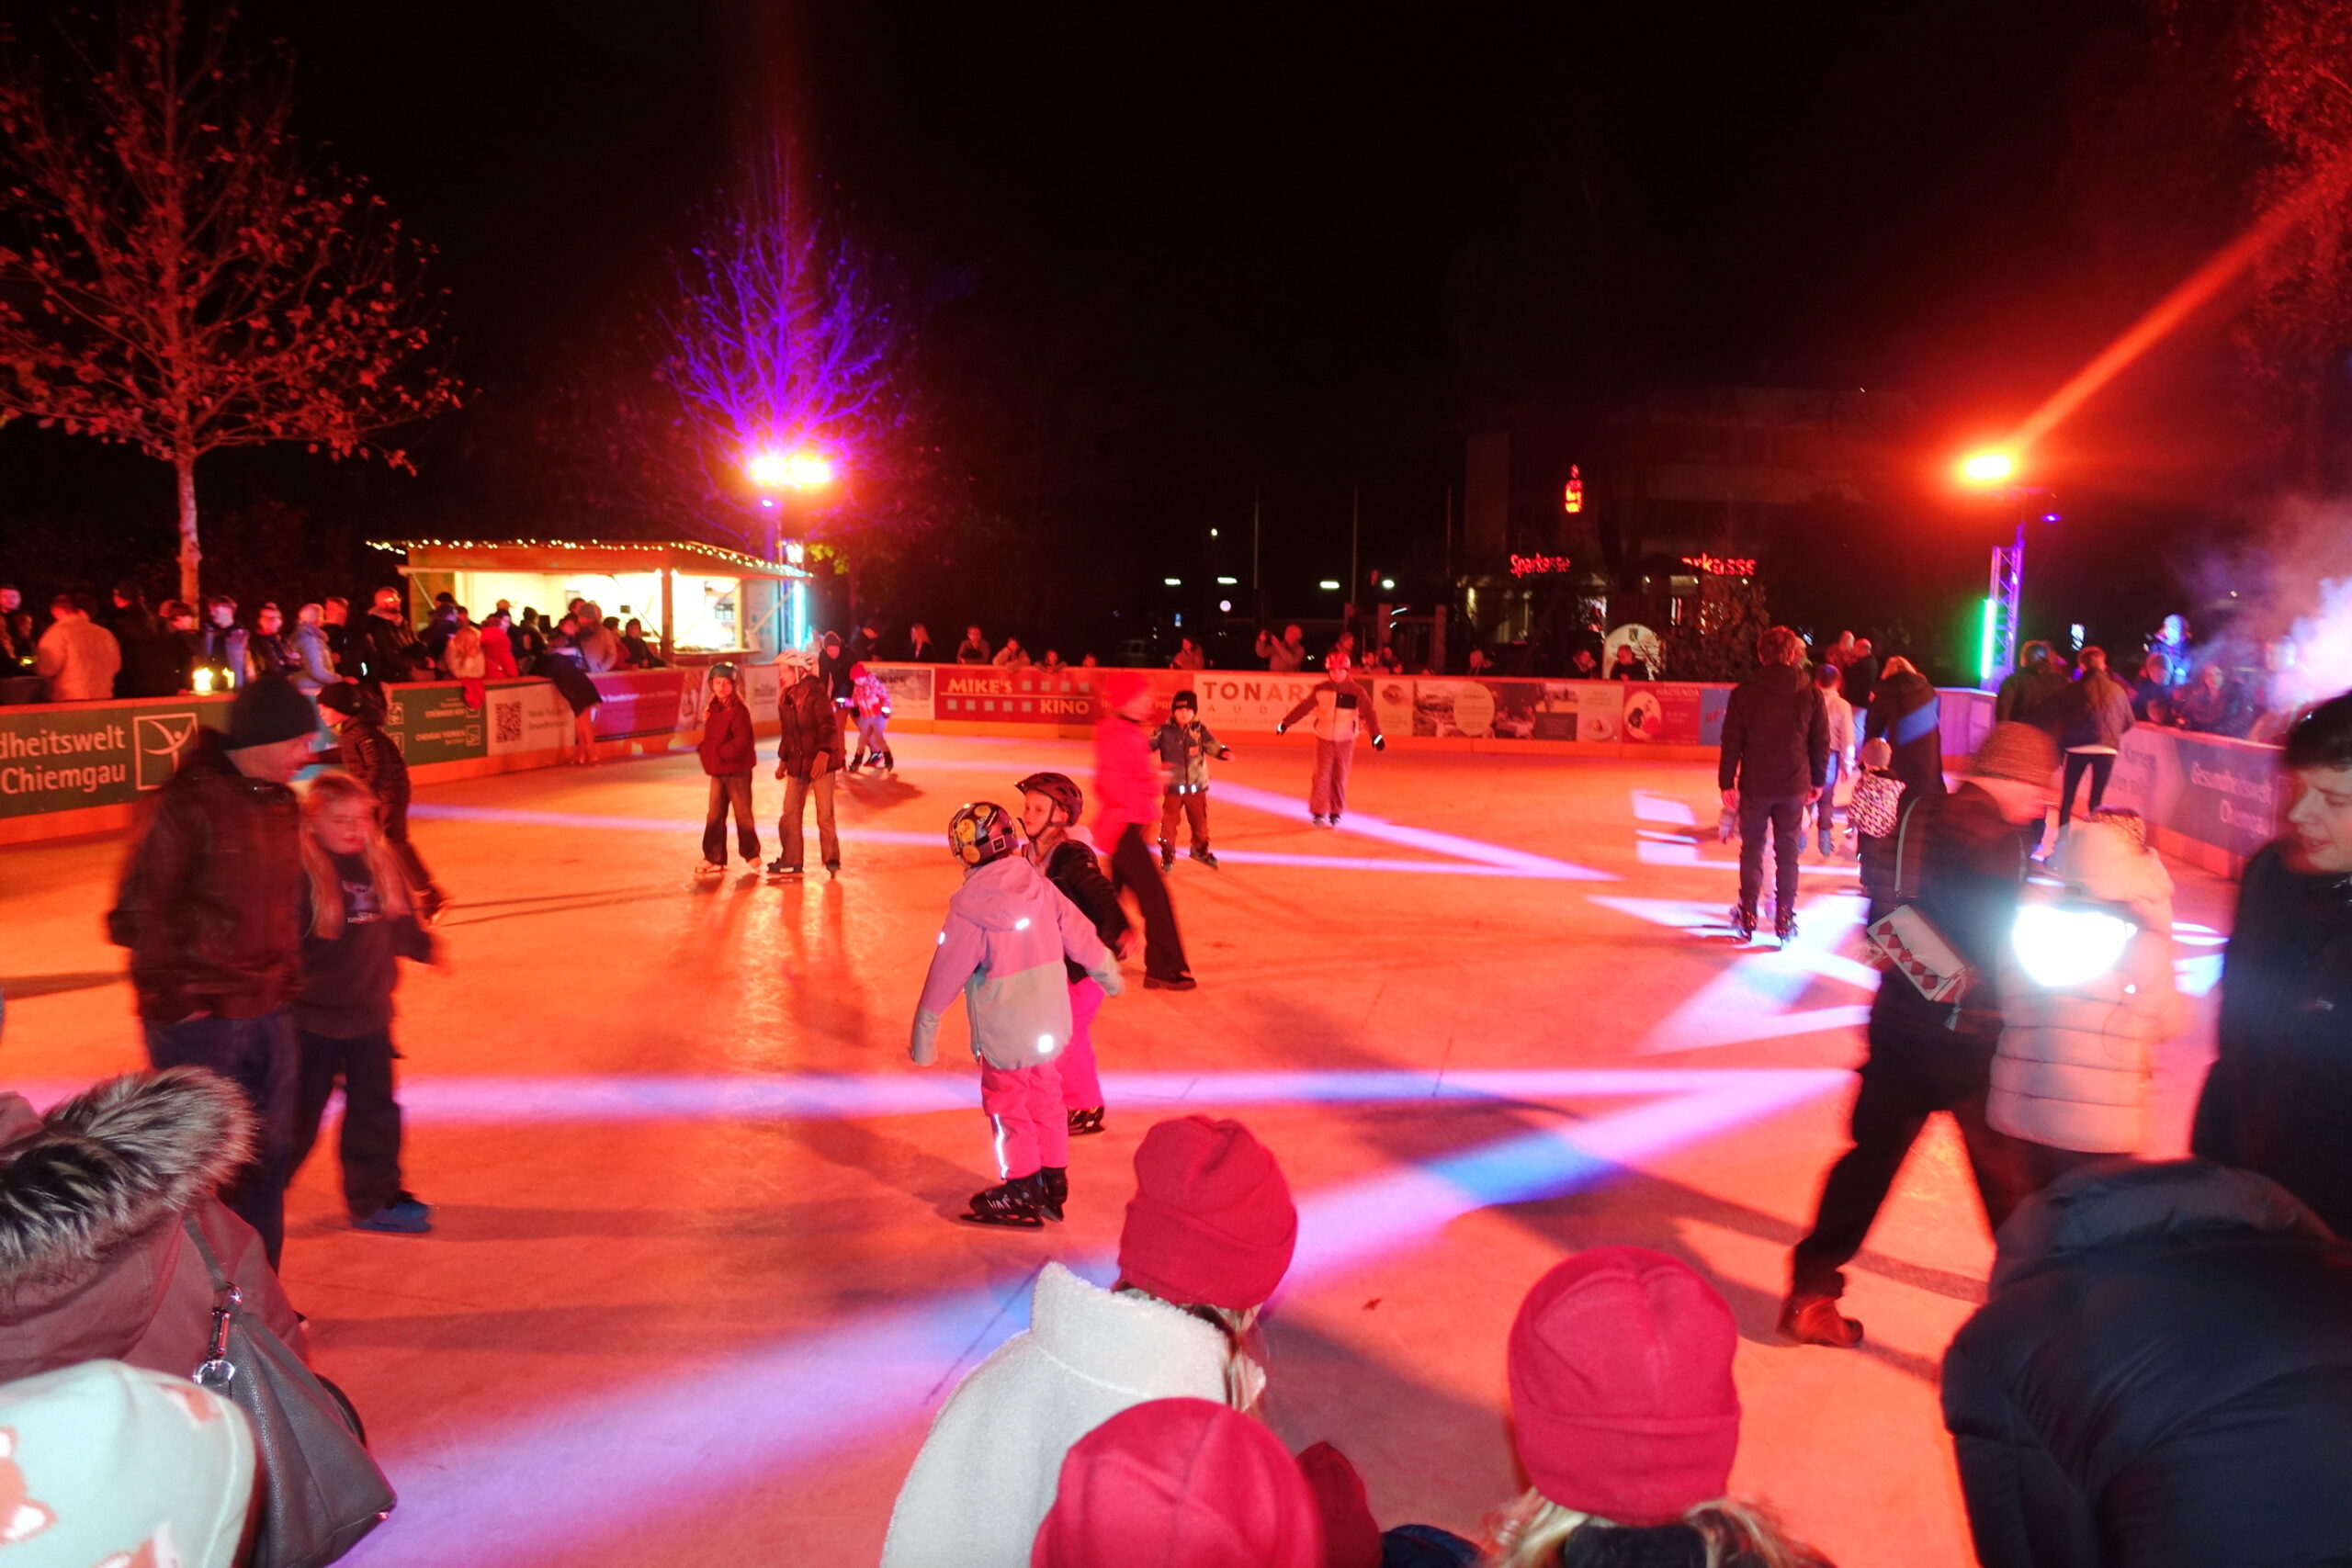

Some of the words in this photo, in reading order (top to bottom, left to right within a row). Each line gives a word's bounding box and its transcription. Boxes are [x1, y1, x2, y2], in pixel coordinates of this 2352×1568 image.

[948, 678, 1013, 694] MIKE'S
[1203, 682, 1314, 703] TONAR
[1040, 699, 1090, 716] KINO
[1, 764, 126, 795] Chiemgau
